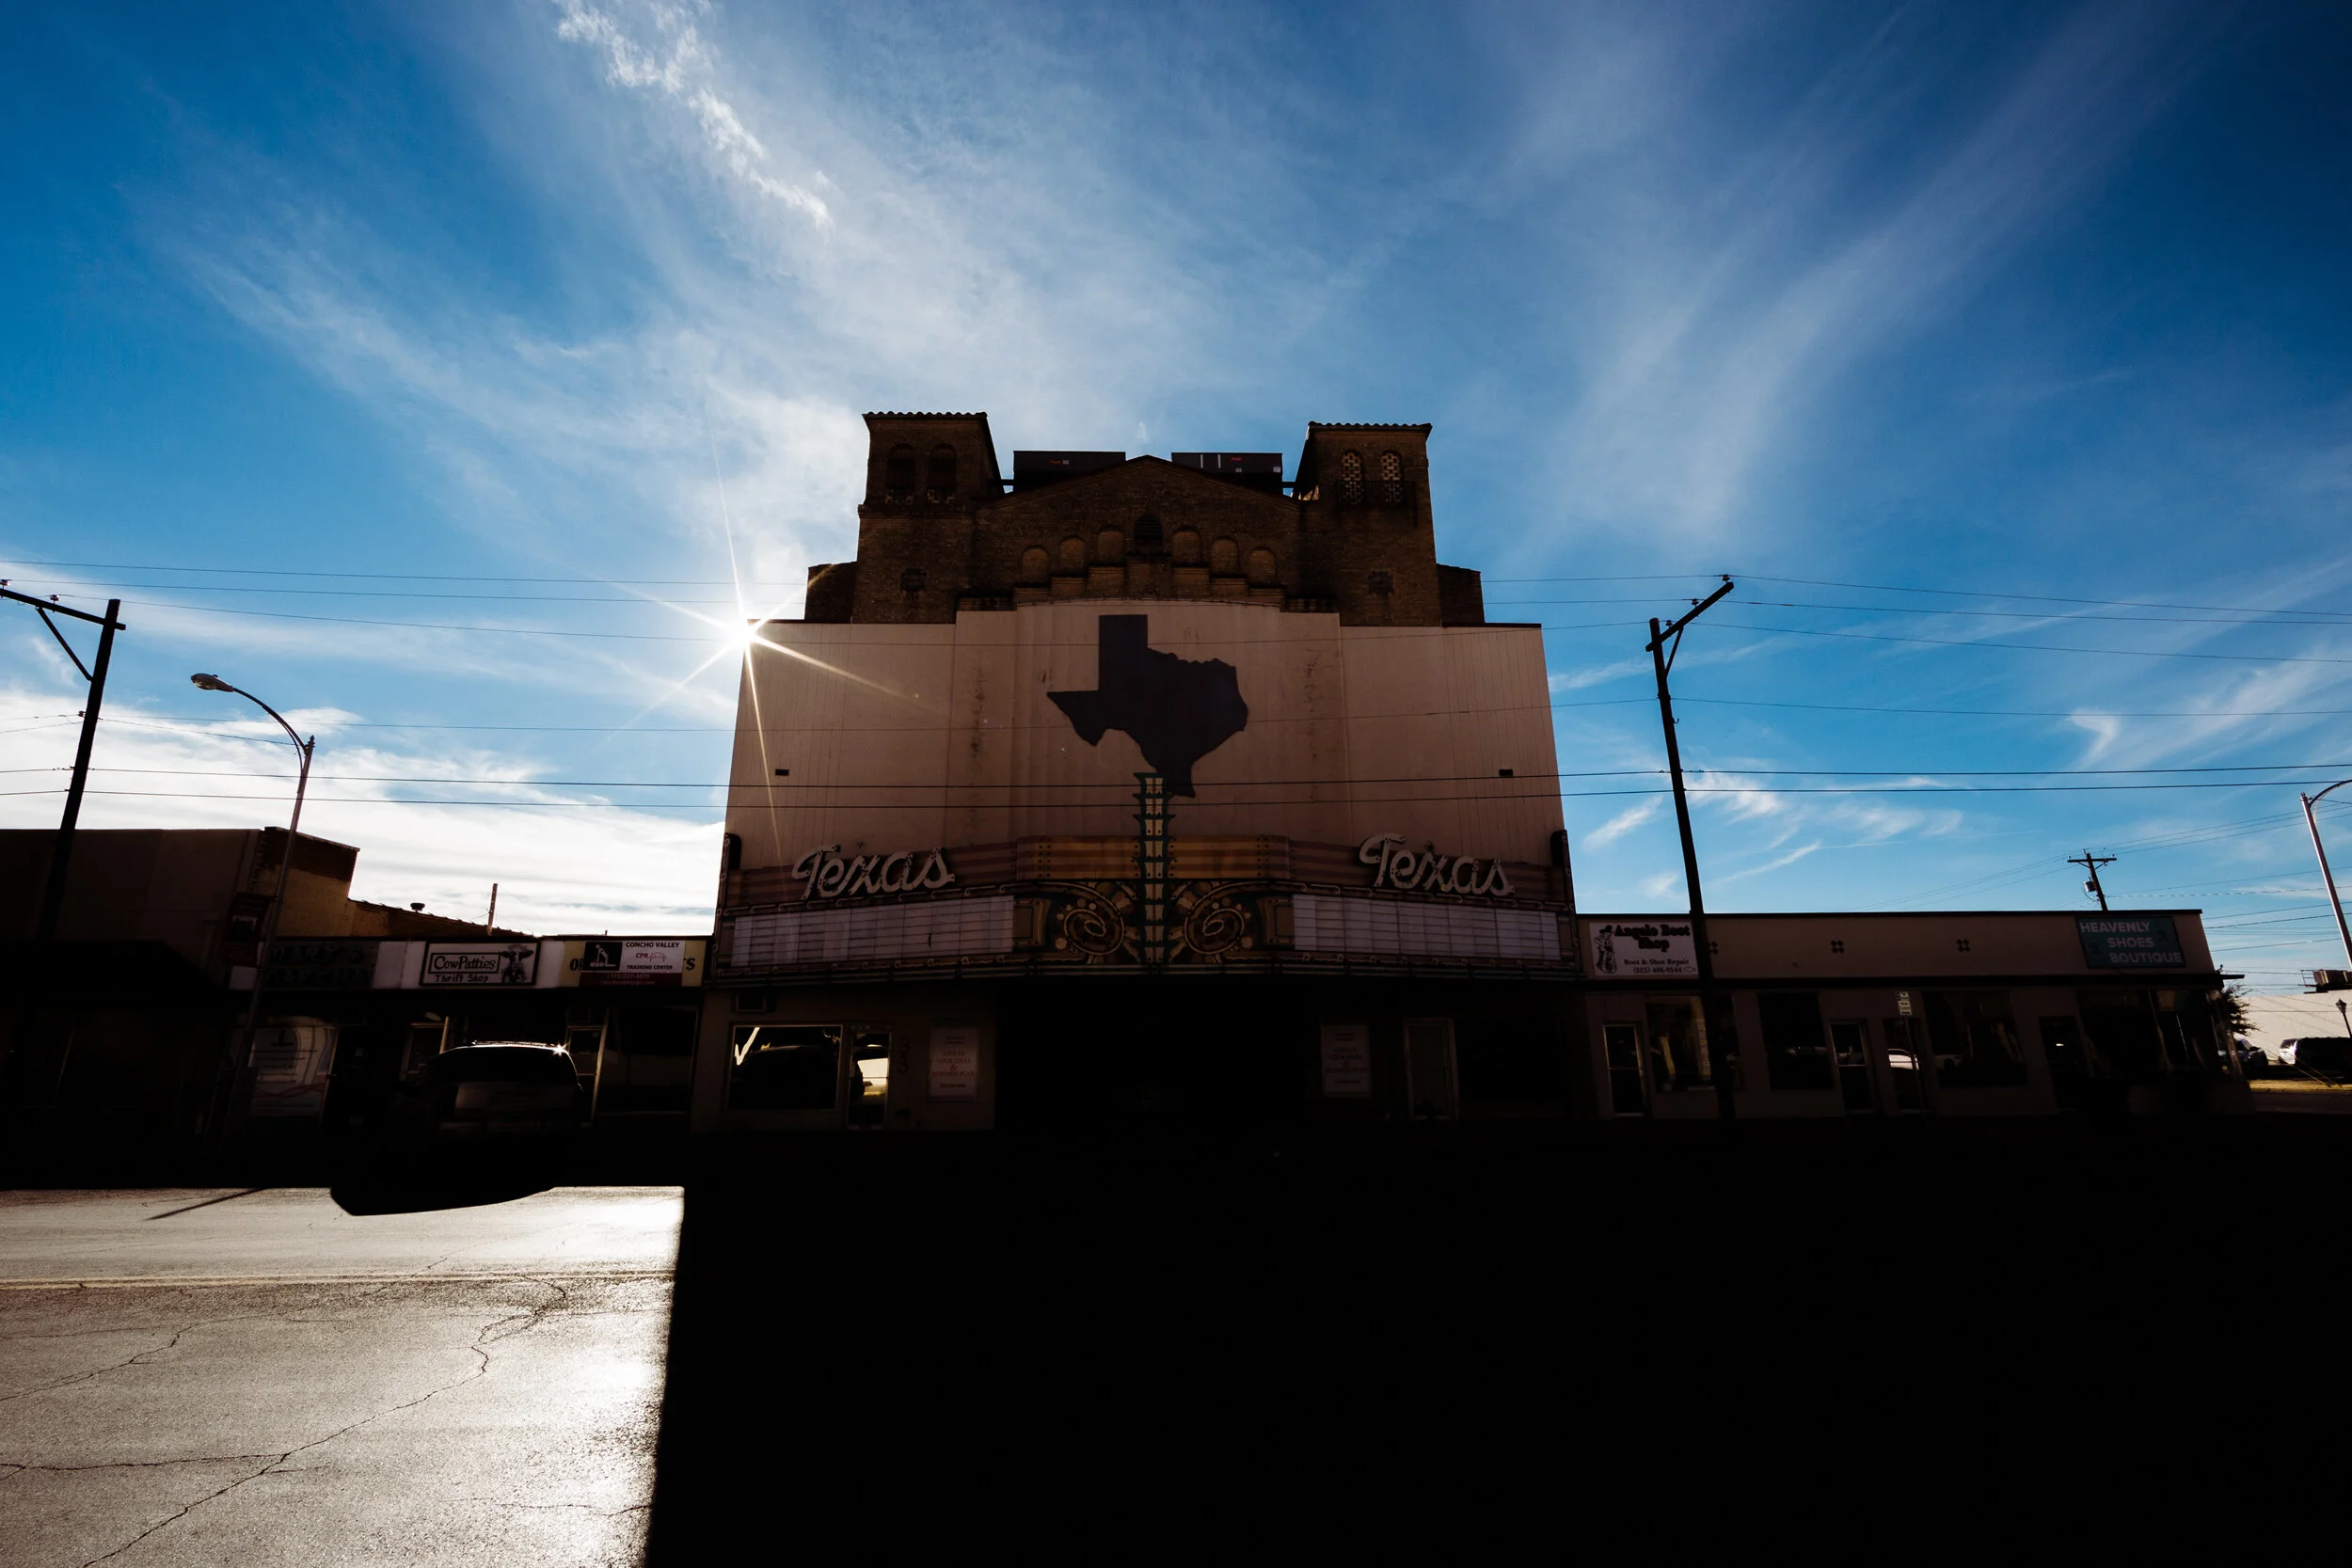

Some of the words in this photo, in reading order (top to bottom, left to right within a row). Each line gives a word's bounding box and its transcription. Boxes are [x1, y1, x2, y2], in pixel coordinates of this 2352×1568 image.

[1359, 832, 1516, 896] Texas
[791, 845, 956, 900] Texas
[2079, 922, 2150, 933] HEAVENLY
[2107, 937, 2154, 948] SHOES
[434, 955, 496, 970] CowPatties
[2108, 952, 2183, 963] BOUTIQUE
[469, 974, 489, 983] Shop
